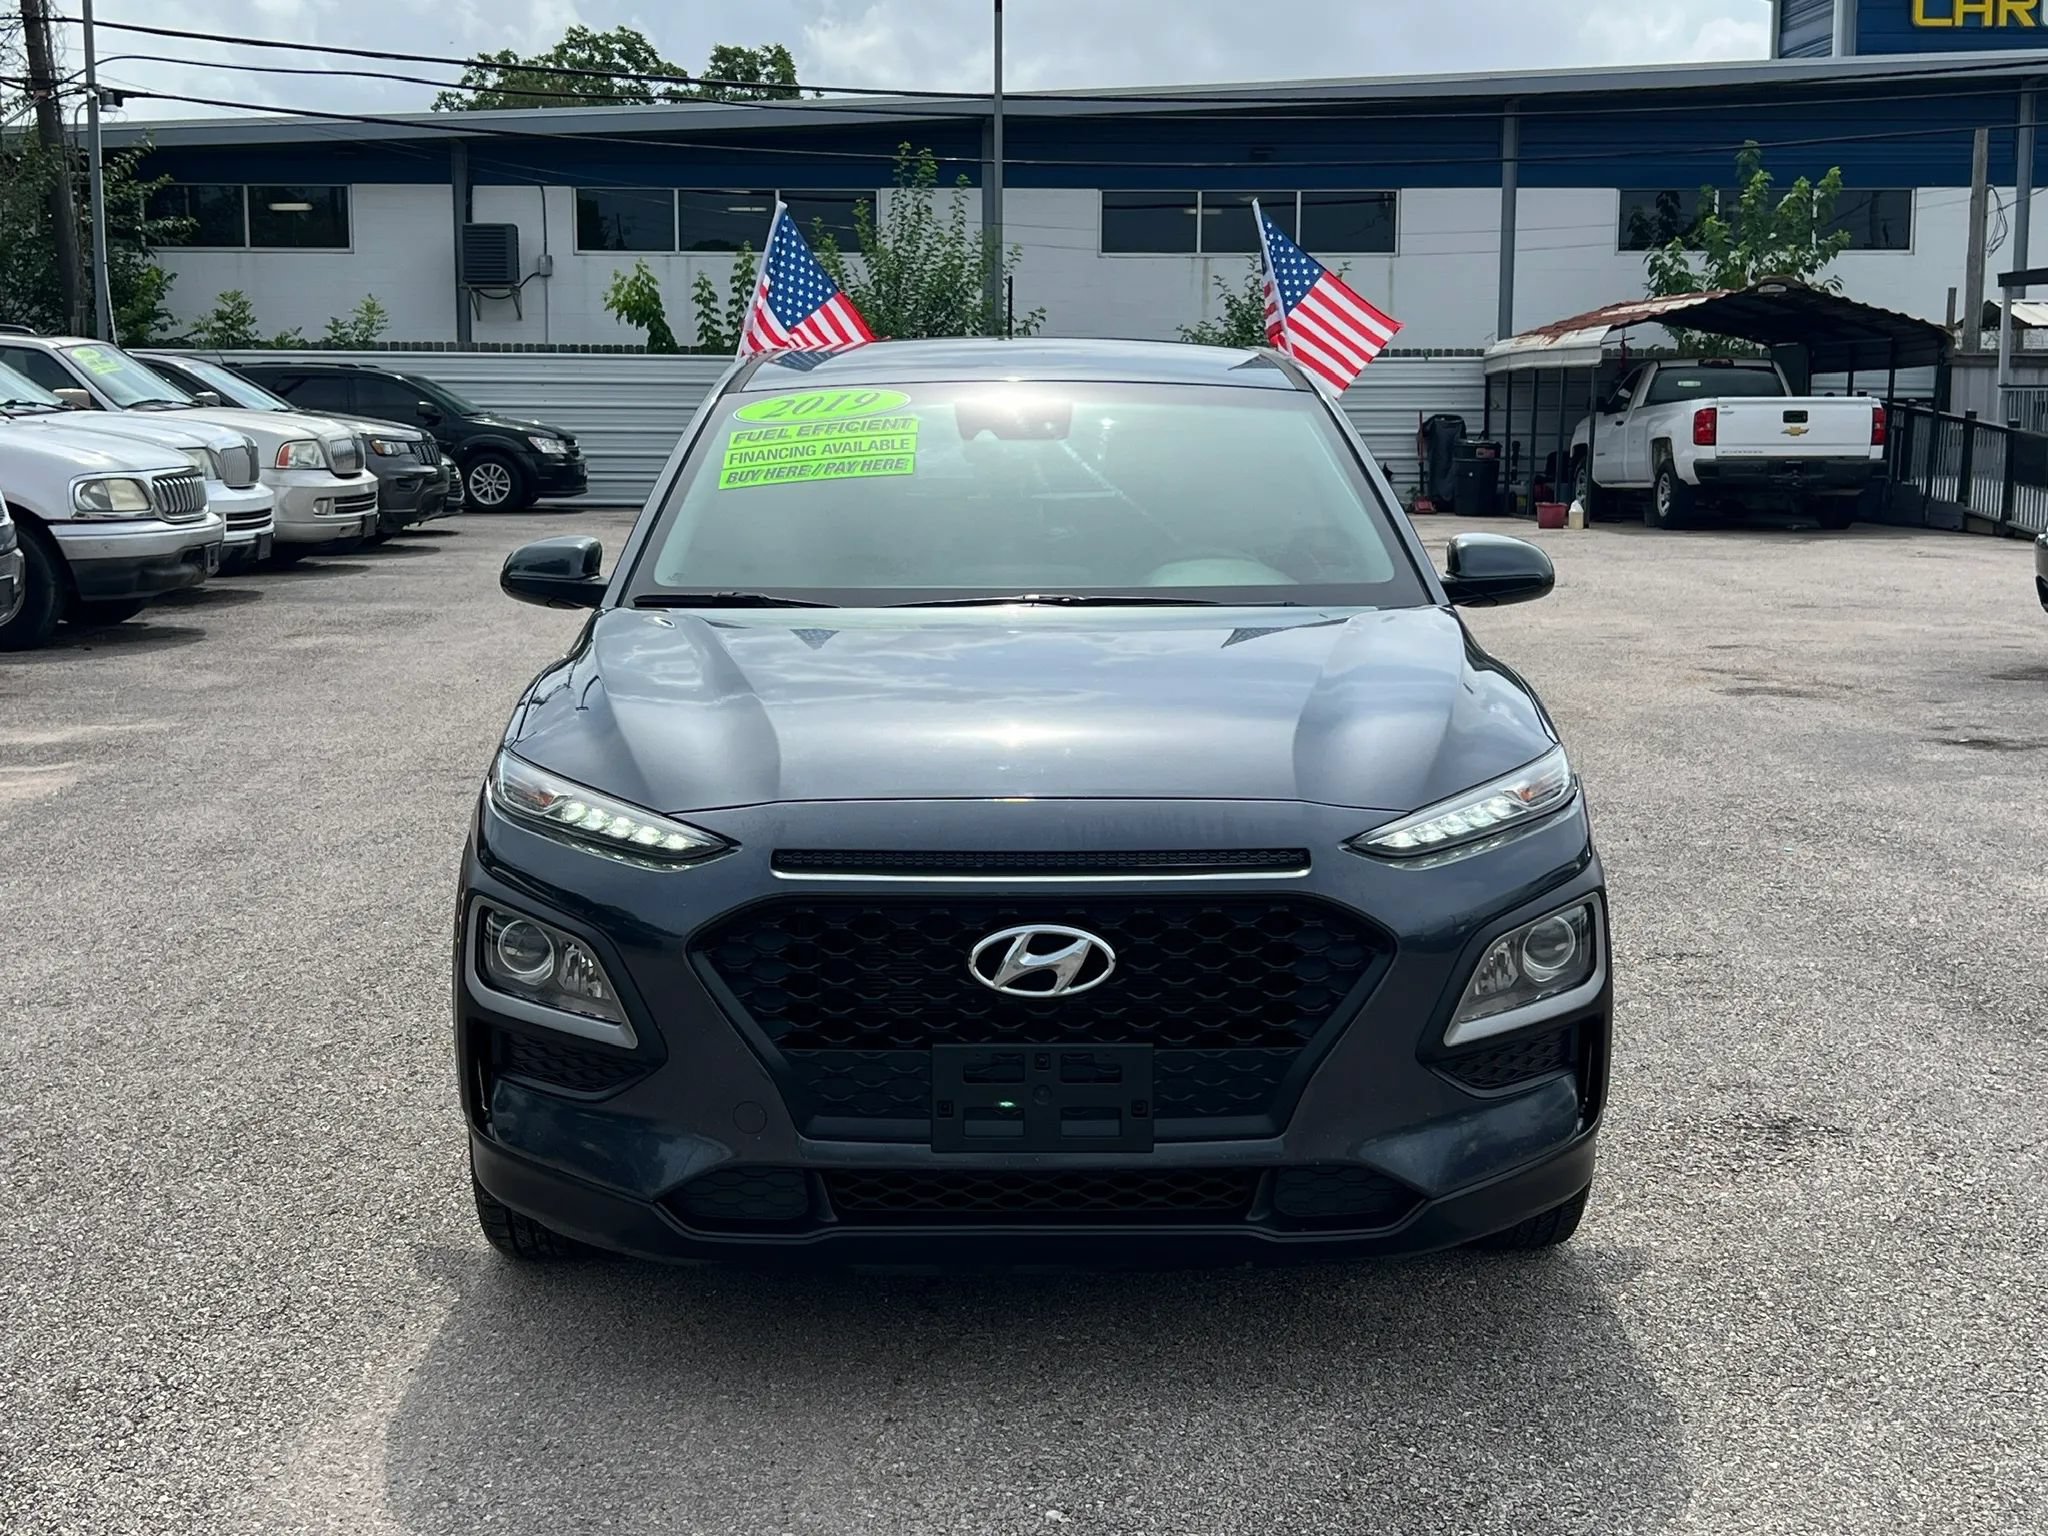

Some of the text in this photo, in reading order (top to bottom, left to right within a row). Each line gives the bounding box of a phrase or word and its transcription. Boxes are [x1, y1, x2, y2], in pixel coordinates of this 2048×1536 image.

[762, 392, 880, 418] 2019
[733, 418, 914, 444] FUEL EFFICIENT
[729, 438, 910, 465] FINANCING AVAILABLE
[726, 469, 765, 485] BUY
[765, 464, 810, 480] HERE
[823, 461, 859, 476] PAY
[861, 457, 908, 473] HERE
